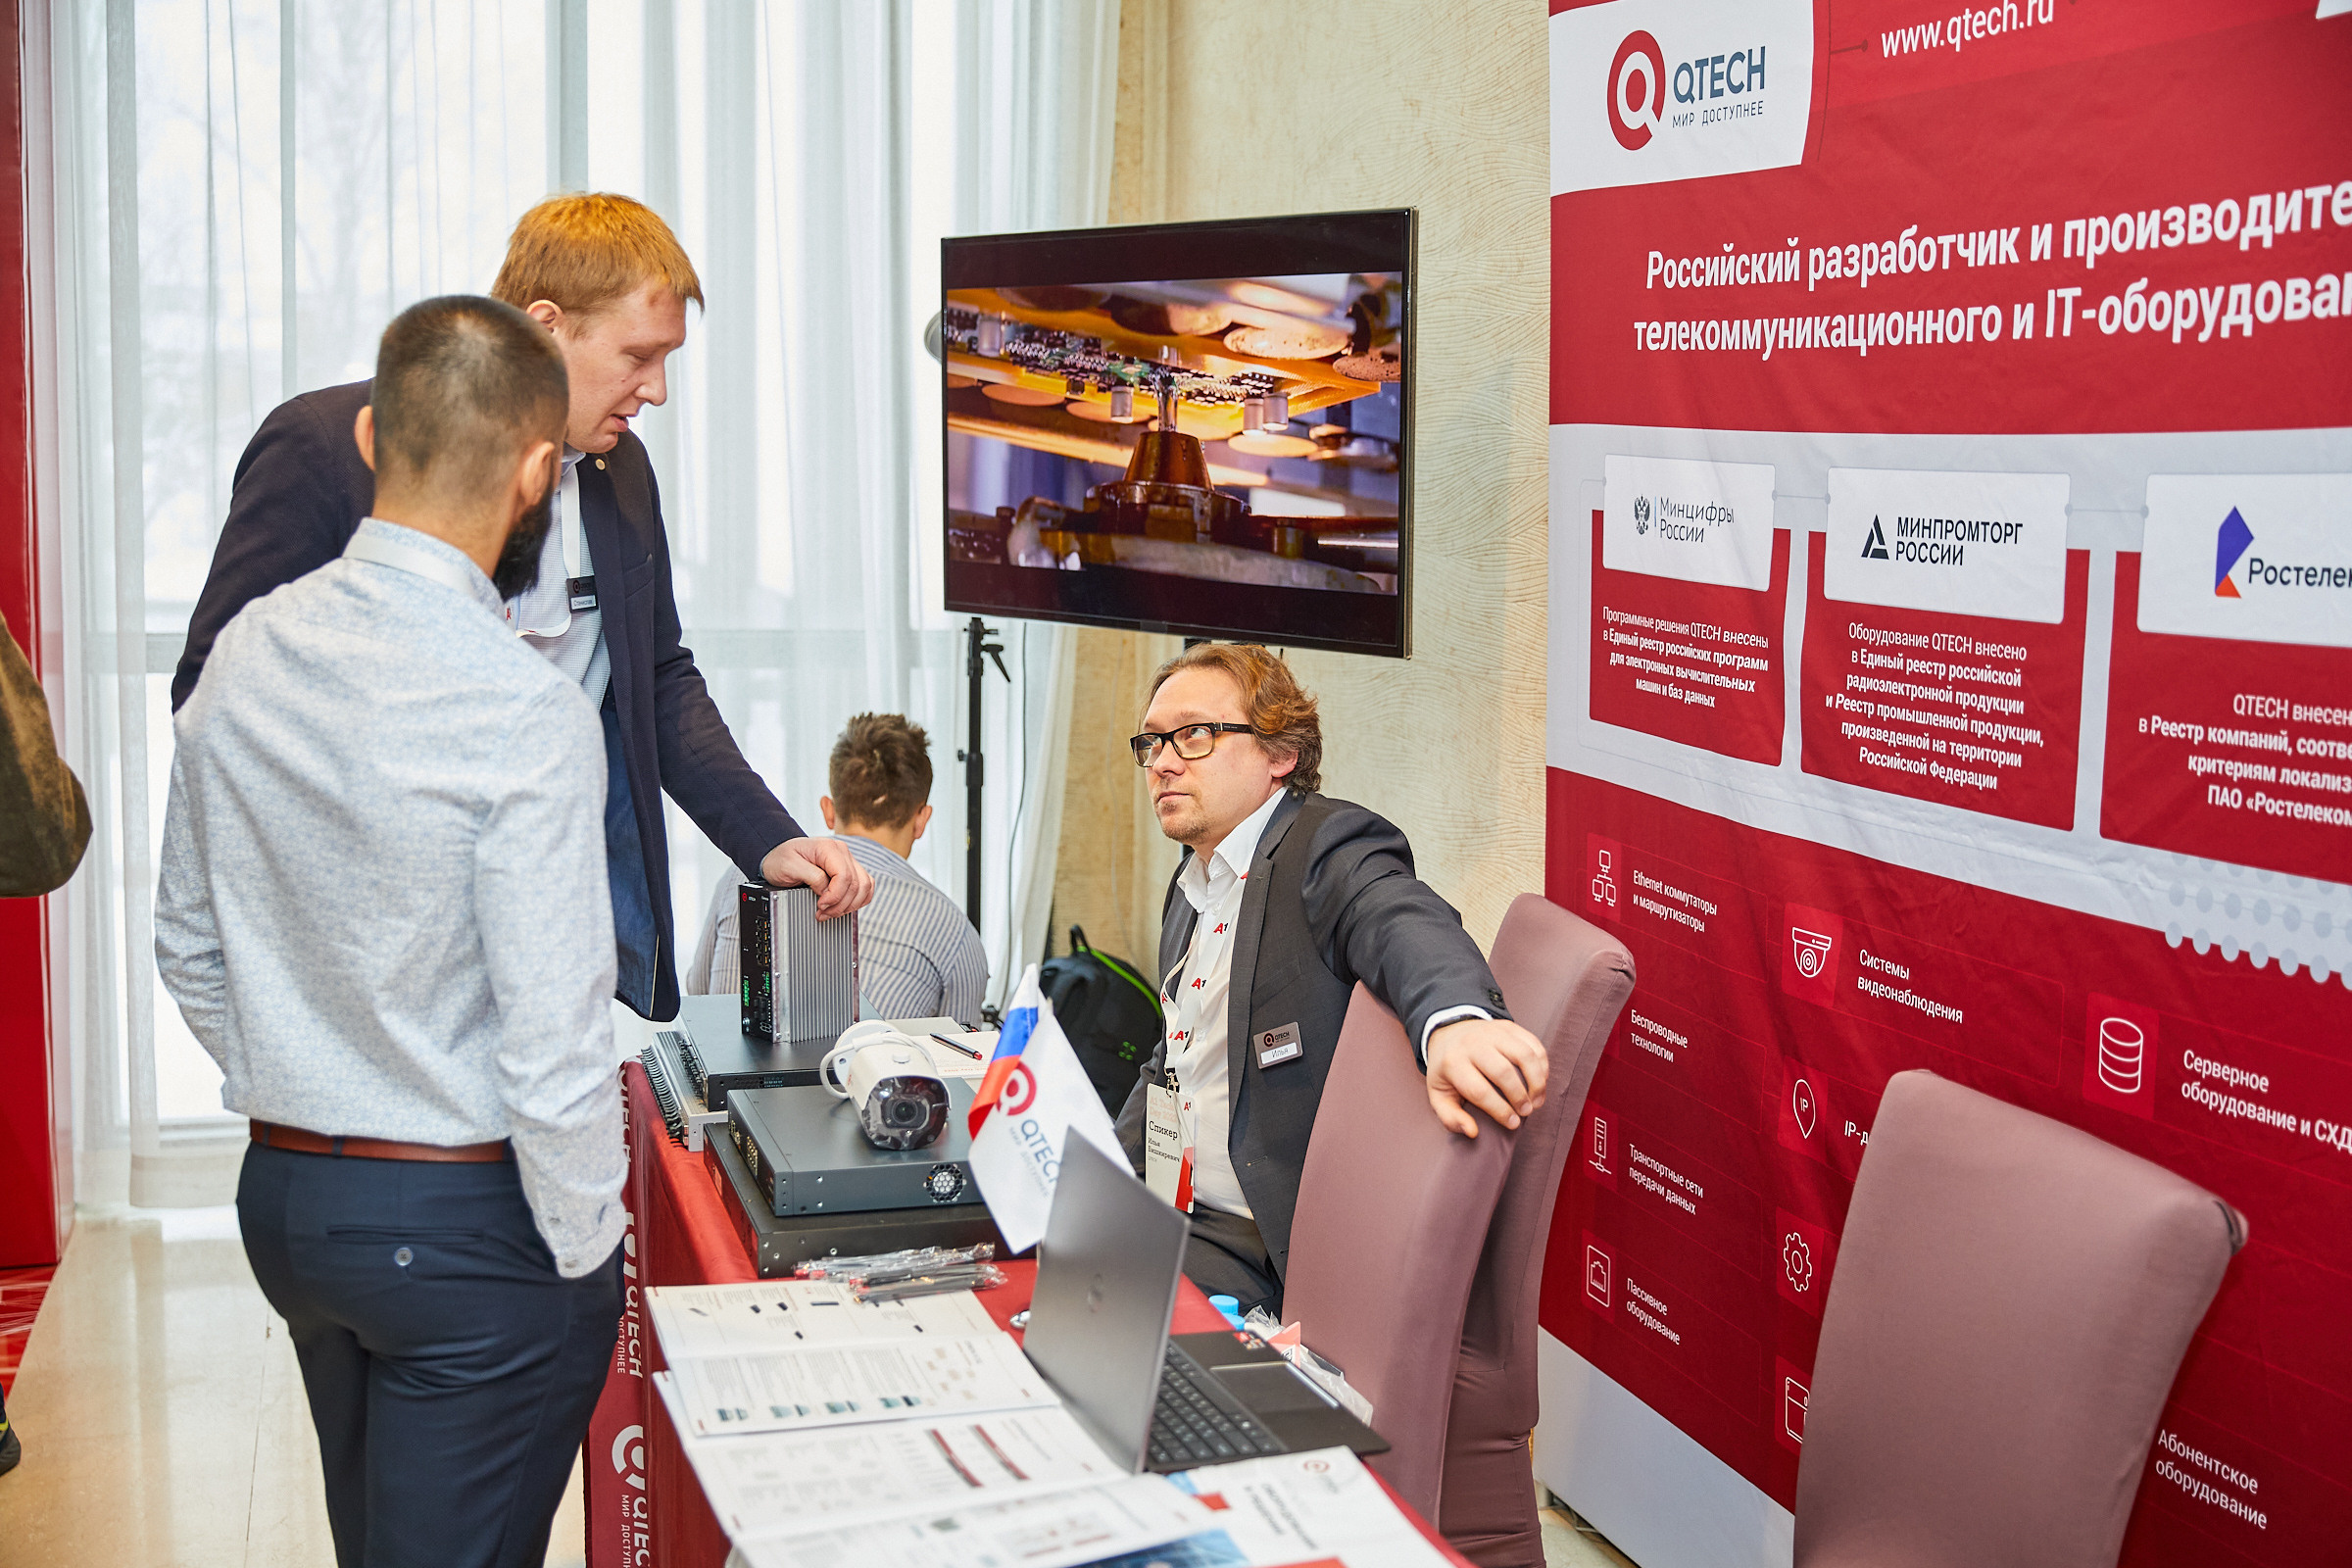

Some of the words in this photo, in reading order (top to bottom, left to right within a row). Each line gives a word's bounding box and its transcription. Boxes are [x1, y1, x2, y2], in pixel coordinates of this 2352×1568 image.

[1882, 0, 2054, 58] www.qtech.ru
[1673, 46, 1766, 105] QTECH
[1672, 112, 1695, 128] МИР
[1701, 101, 1764, 126] ДОСТУПНЕЕ
[1646, 236, 1801, 290] Российский
[1808, 224, 2021, 292] разработчик
[2030, 222, 2053, 262] и
[1634, 305, 2003, 361] телекоммуникационного
[2012, 302, 2034, 340] и
[1660, 496, 1735, 527] Минцифры
[1660, 518, 1704, 543] России
[1896, 516, 2024, 545] МИНПРОМТОРГ
[1895, 540, 1964, 566] РОССИИ
[1602, 606, 1654, 629] Программные
[1655, 618, 1690, 635] решения
[1690, 621, 1721, 642] QTECH
[1723, 631, 1769, 649] внесены
[1848, 621, 1930, 649] Оборудование
[1932, 632, 1973, 655] QTECH
[1975, 641, 2028, 662] внесено
[1603, 630, 1608, 641] в
[1609, 628, 1639, 647] Единый
[1640, 637, 1664, 656] реестр
[1666, 643, 1711, 662] российских
[1713, 651, 1769, 672] программ
[1851, 650, 1858, 663] в
[1860, 648, 1904, 670] Единый
[1906, 659, 1946, 677] реестр
[1948, 663, 2022, 688] российской
[1610, 652, 1625, 665] для
[1625, 655, 1676, 677] электронных
[1676, 667, 1755, 693] вычислительных
[1636, 678, 1661, 695] машин
[1661, 684, 1667, 697] и
[1668, 682, 1684, 701] баз
[1684, 689, 1716, 709] данных
[1846, 673, 1953, 704] радиоэлектронной
[1955, 690, 2025, 715] продукции
[2232, 693, 2289, 719] QTECH
[1826, 695, 1834, 708] и
[1836, 693, 1875, 716] Реестр
[1877, 703, 1968, 732] промышленной
[1970, 718, 2044, 748] продукции,
[2138, 717, 2147, 733] в
[2151, 714, 2204, 745] Реестр
[2207, 726, 2293, 757] компаний,
[1840, 721, 1930, 751] произведенной
[1932, 739, 1946, 754] на
[1949, 742, 2022, 768] территории
[1859, 746, 1928, 775] Российской
[1929, 760, 1998, 790] Федерации
[2187, 755, 2277, 782] критериям
[2207, 784, 2242, 809] ПАО
[1633, 869, 1663, 895] Ethernet
[1664, 884, 1717, 916] коммутаторы
[1633, 894, 1638, 906] и
[1639, 896, 1705, 933] маршрутизаторы
[1860, 949, 1910, 980] Системы
[1857, 976, 1963, 1024] видеонаблюдения
[1631, 1008, 1689, 1049] Беспроводные
[1631, 1032, 1674, 1063] технологии
[2183, 1049, 2270, 1093] Серверное
[1184, 1102, 1192, 1111] A1
[2181, 1081, 2297, 1132] оборудование
[2300, 1118, 2311, 1137] и
[2314, 1118, 2352, 1155] СХД
[1021, 1118, 1060, 1184] QTEC
[1149, 1120, 1178, 1141] Спикер
[1629, 1143, 1685, 1188] Транспортные
[1685, 1179, 1704, 1199] сети
[1629, 1166, 1665, 1197] передачи
[1665, 1189, 1696, 1216] данных
[1627, 1277, 1668, 1316] Пассивное
[1626, 1300, 1681, 1346] оборудование
[2158, 1429, 2258, 1494] Абонентское
[621, 1494, 630, 1518] МИР
[2155, 1459, 2268, 1530] оборудование
